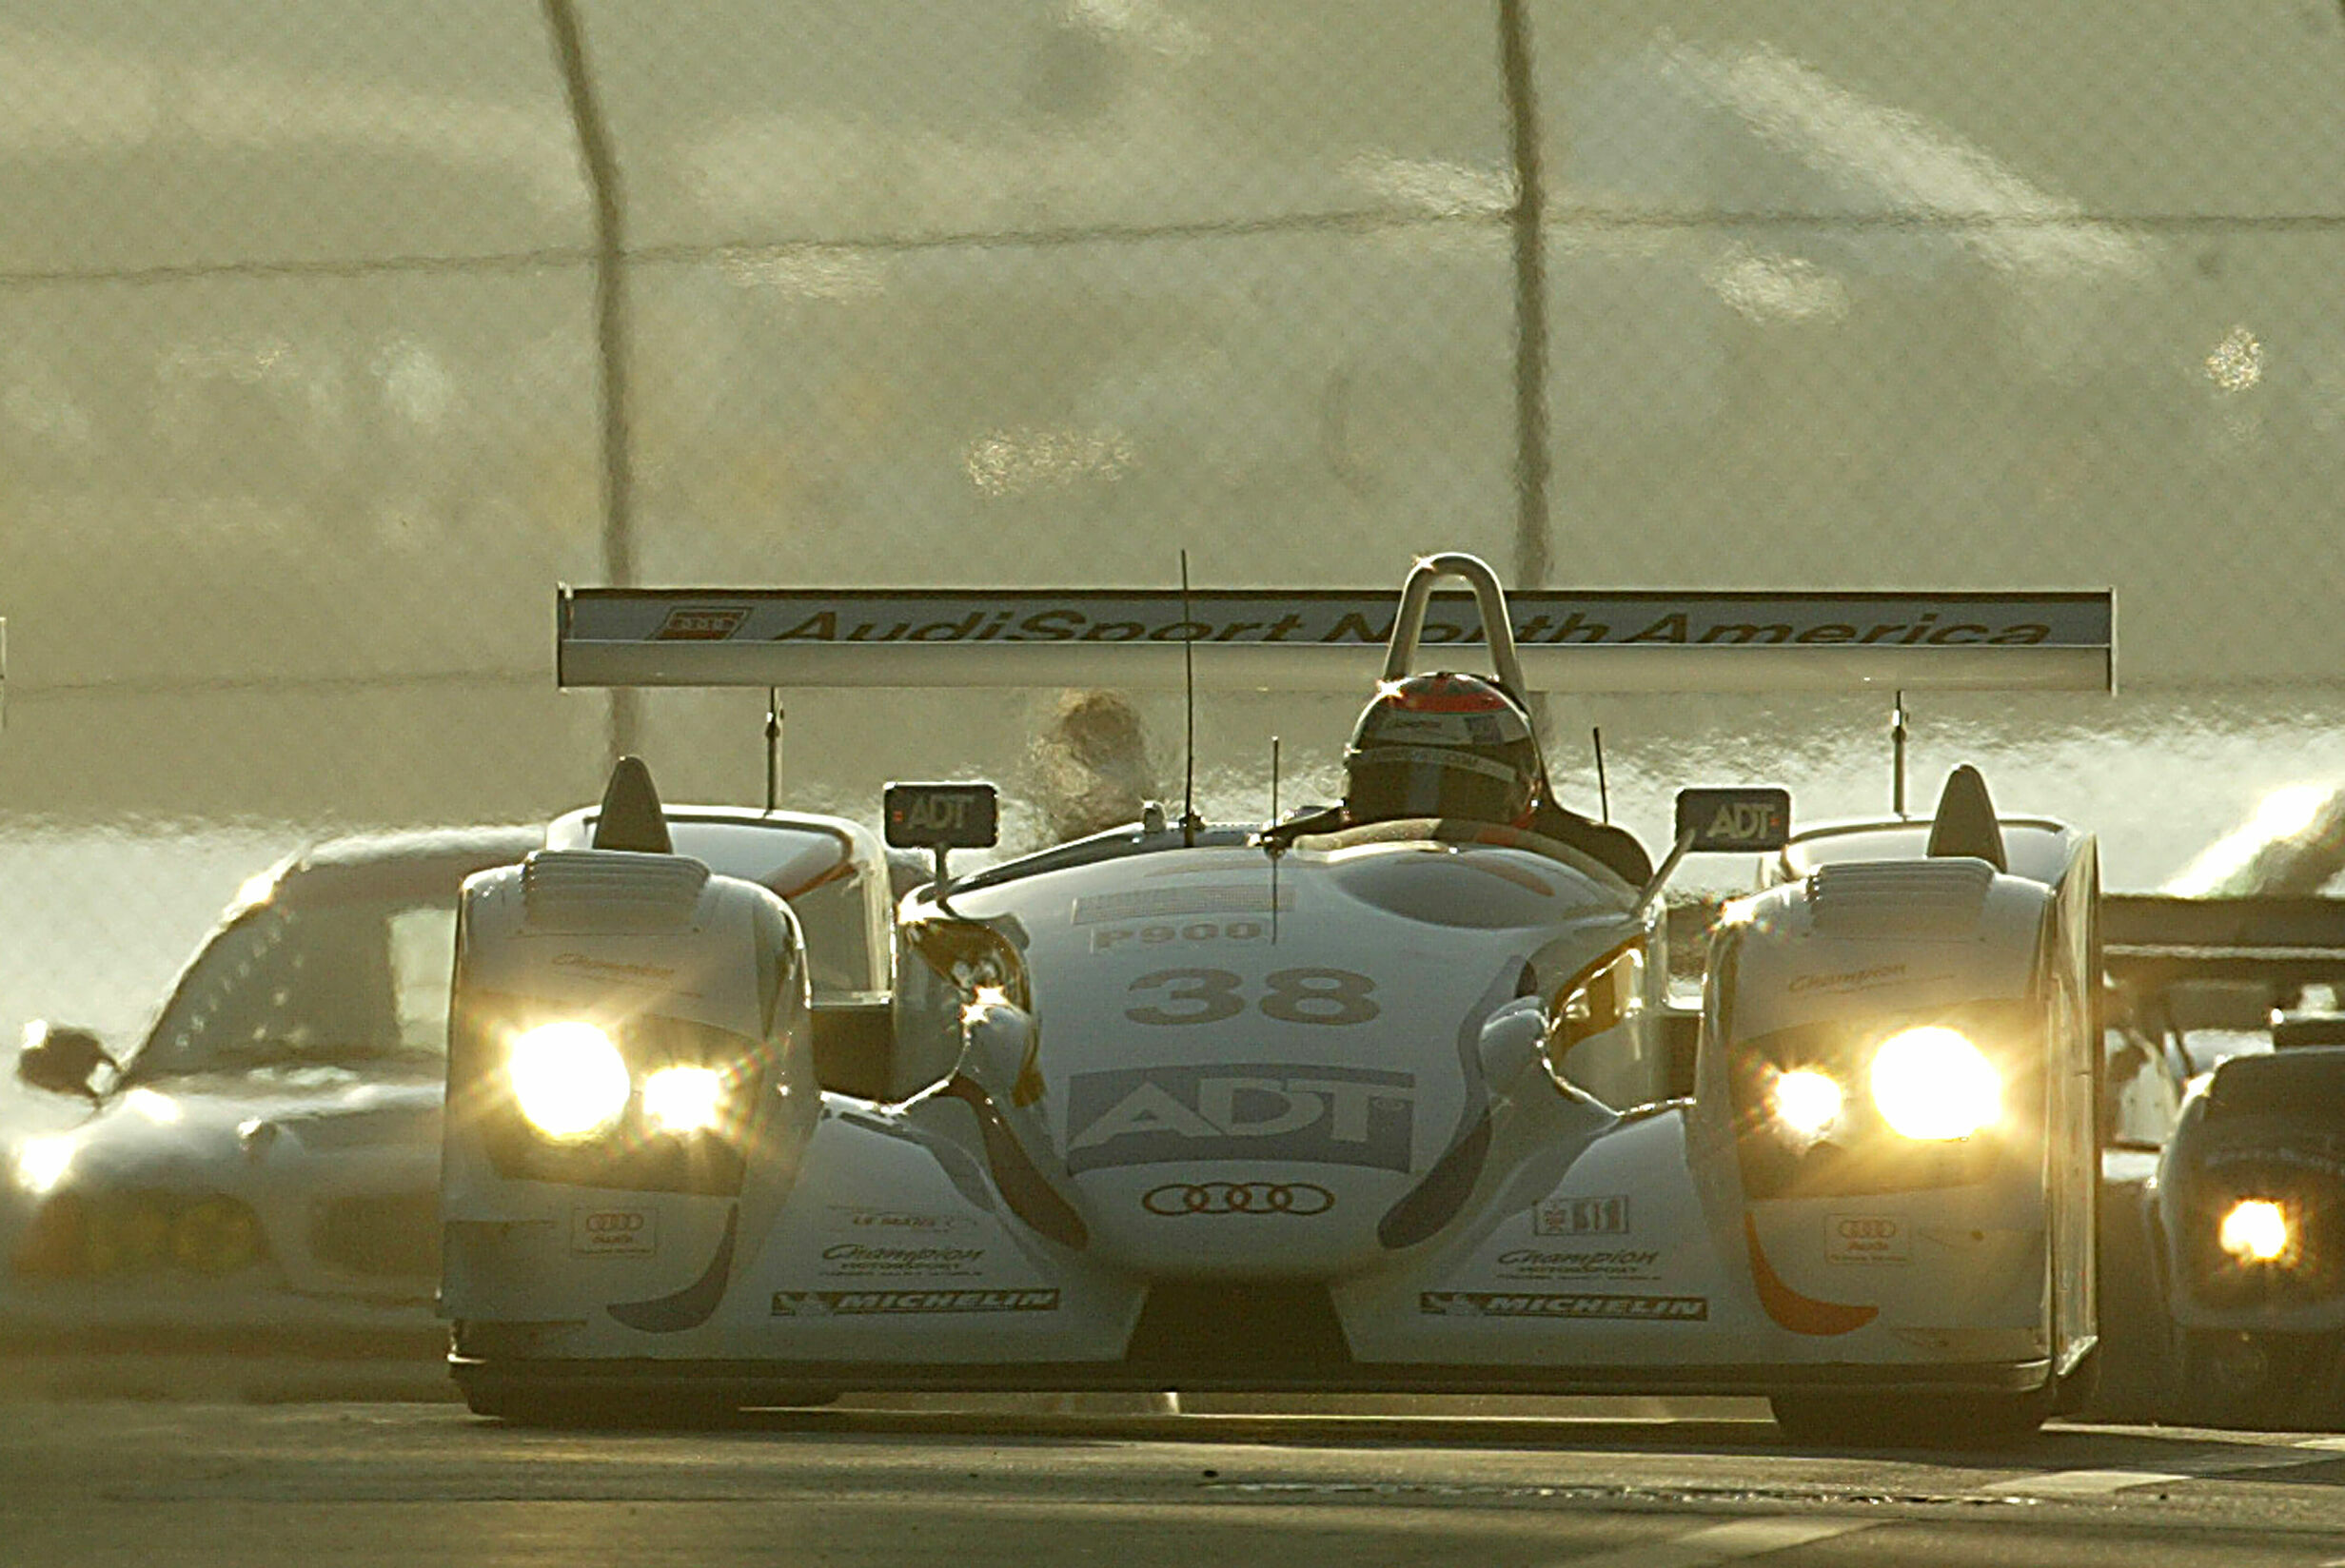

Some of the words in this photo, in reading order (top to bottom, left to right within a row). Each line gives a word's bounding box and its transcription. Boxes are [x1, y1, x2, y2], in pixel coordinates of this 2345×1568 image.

[1618, 613, 2052, 644] America
[907, 794, 975, 830] ADT
[1706, 803, 1775, 839] ADT
[1125, 967, 1382, 1027] 38
[1071, 1078, 1416, 1150] ADT
[1497, 1248, 1660, 1267] Champion
[836, 1292, 1057, 1309] MICHELIN
[1488, 1296, 1704, 1315] MICHELIN
